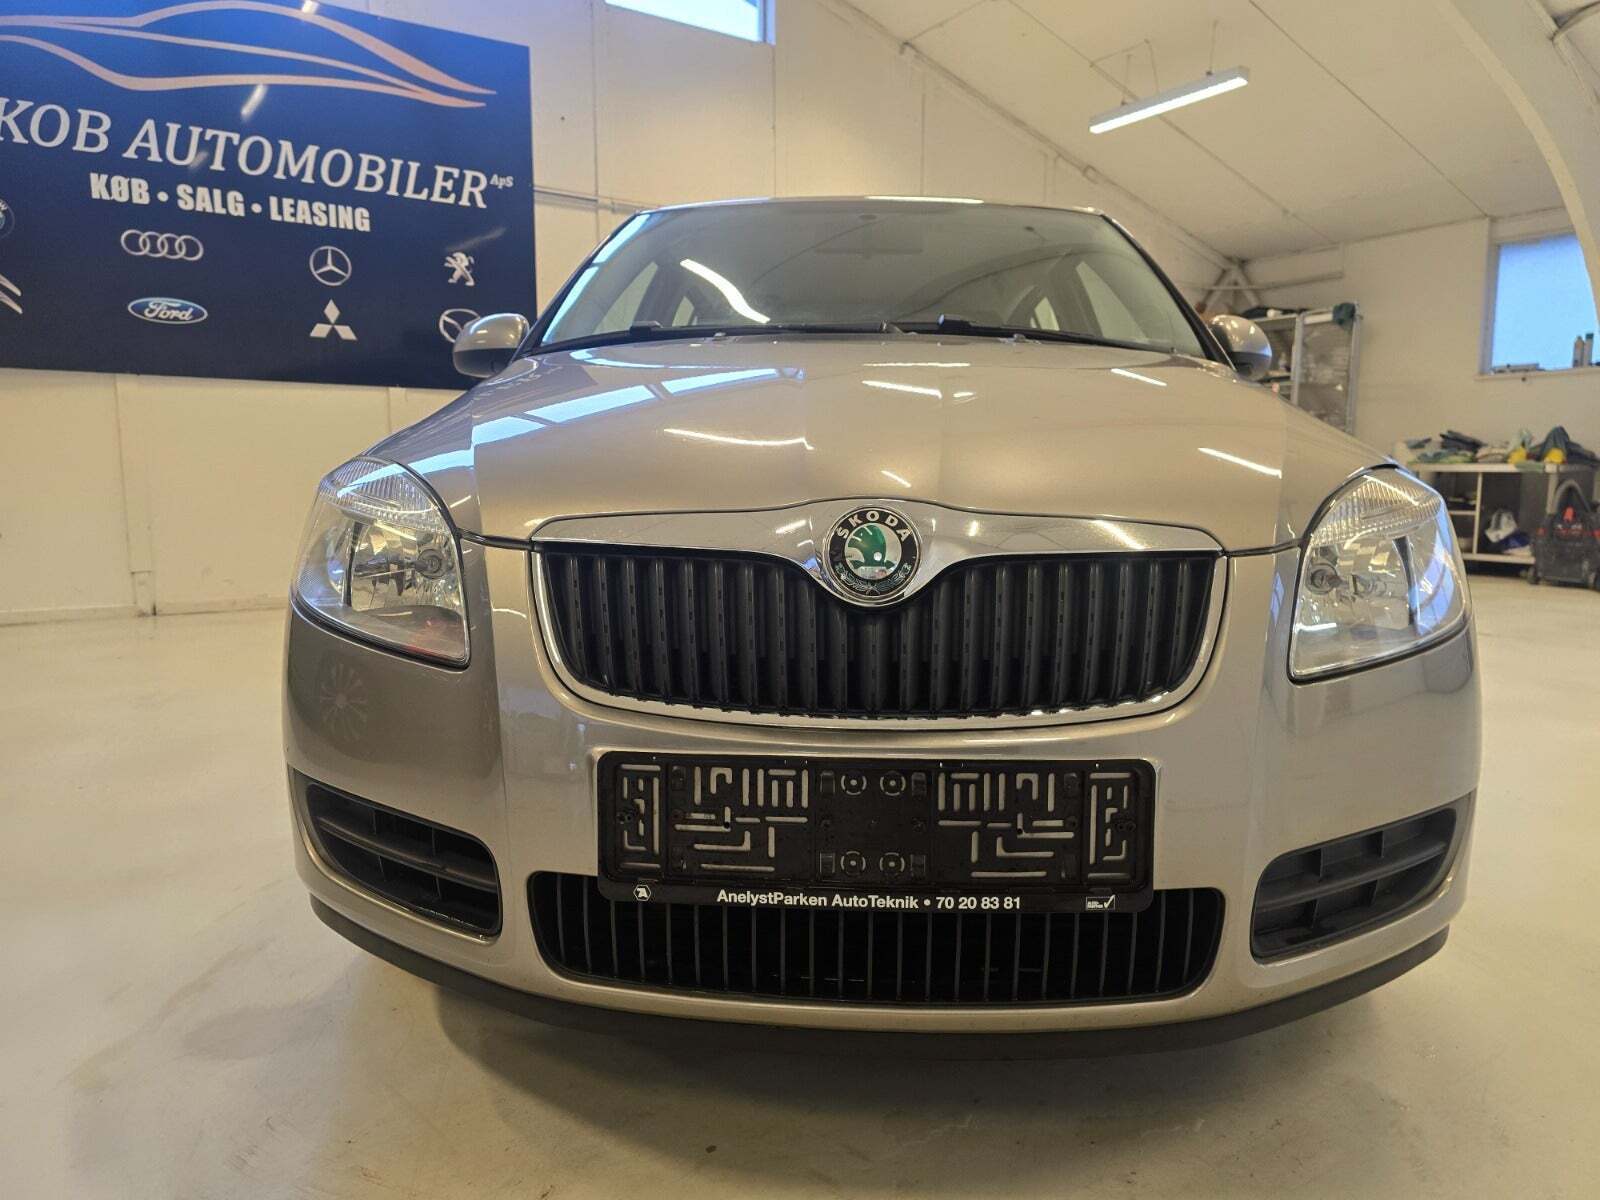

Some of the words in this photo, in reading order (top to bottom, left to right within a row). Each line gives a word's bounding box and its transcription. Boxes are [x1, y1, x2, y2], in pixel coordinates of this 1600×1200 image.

[122, 118, 488, 209] AUTOMOBILER
[489, 173, 514, 189] ApS
[89, 172, 150, 205] KØB
[176, 183, 245, 217] SALG
[268, 195, 371, 232] LEASING
[144, 301, 194, 321] Ford
[831, 894, 919, 909] AutoTeknik
[936, 896, 954, 909] 70
[958, 896, 977, 910] 20
[981, 896, 1000, 910] 83
[1003, 896, 1021, 910] 81
